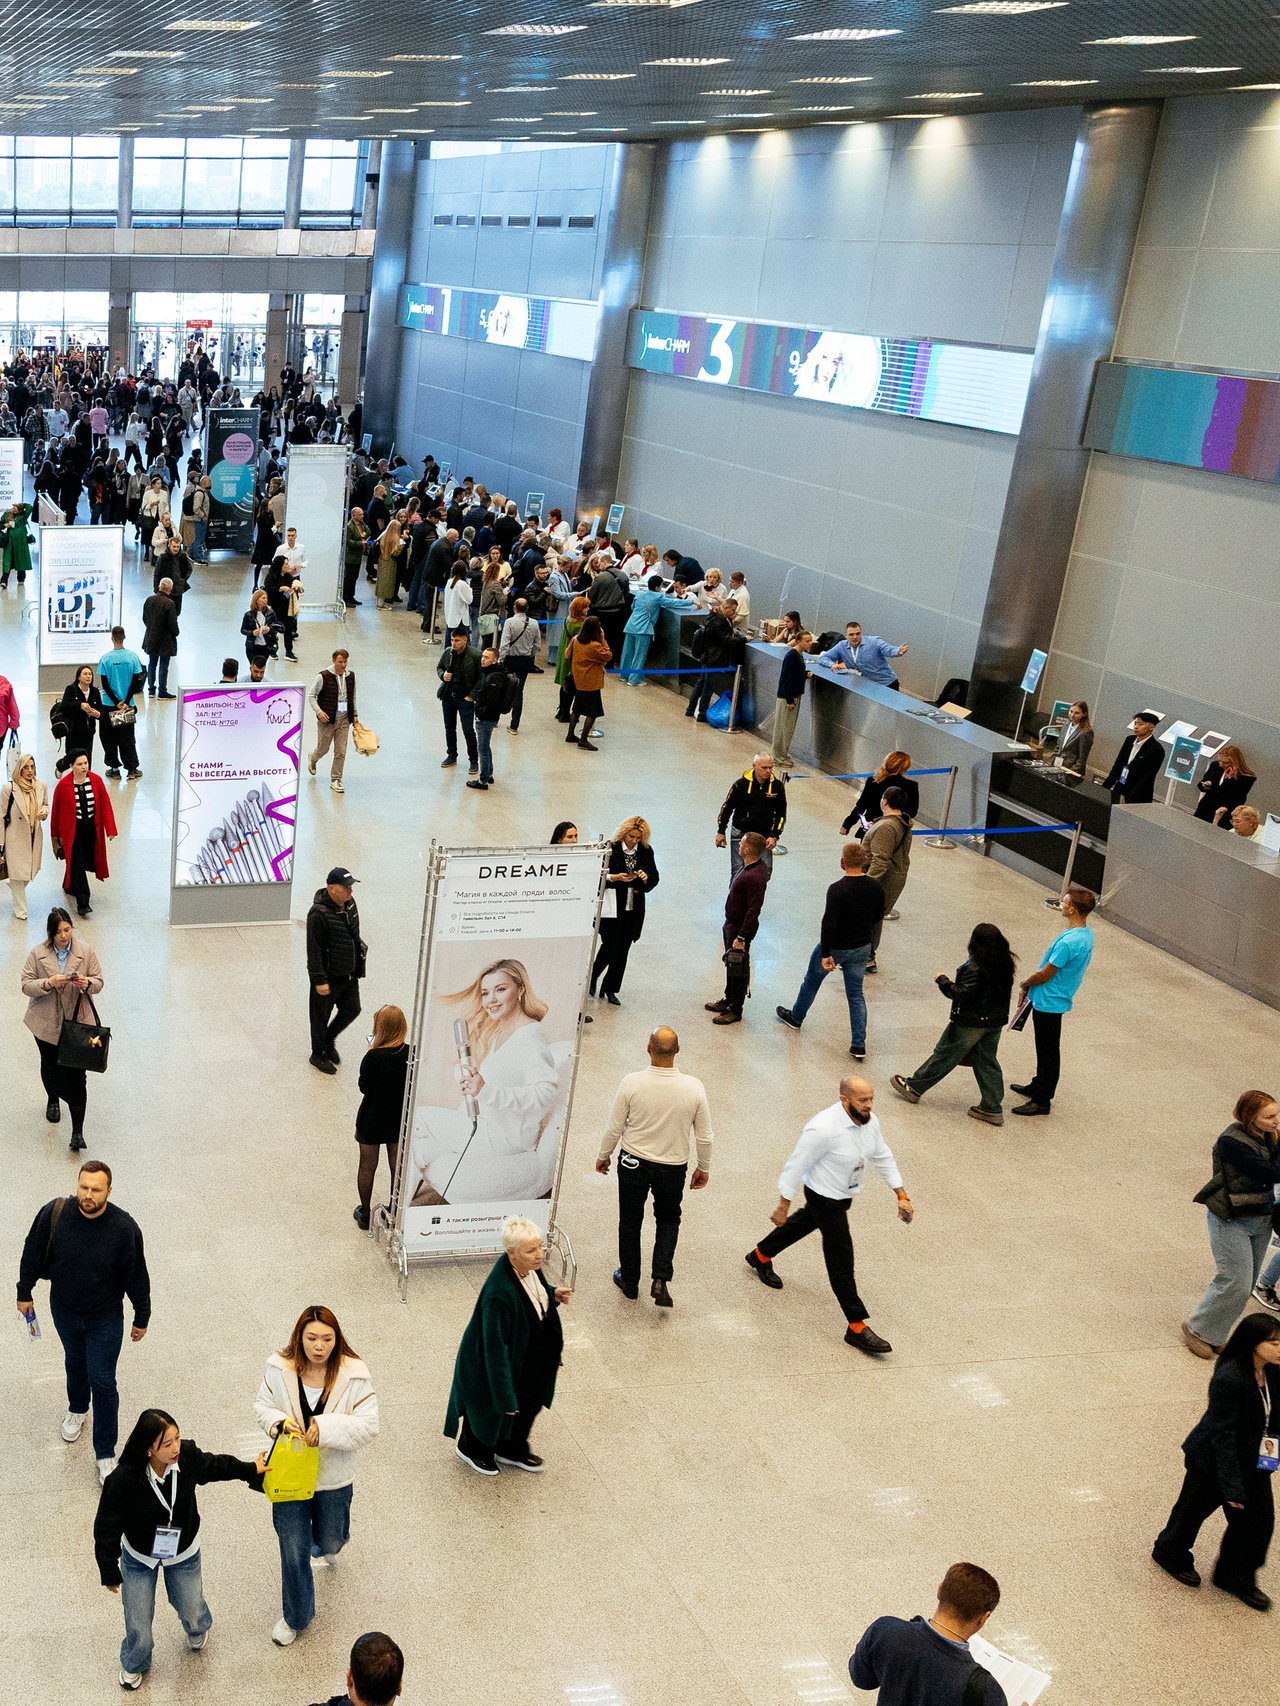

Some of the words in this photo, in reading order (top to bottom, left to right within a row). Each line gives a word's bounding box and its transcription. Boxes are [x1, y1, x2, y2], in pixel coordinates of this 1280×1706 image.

[648, 333, 690, 354] interCHARM
[697, 318, 736, 385] 3
[479, 864, 568, 879] DREAME
[489, 889, 517, 898] каждой
